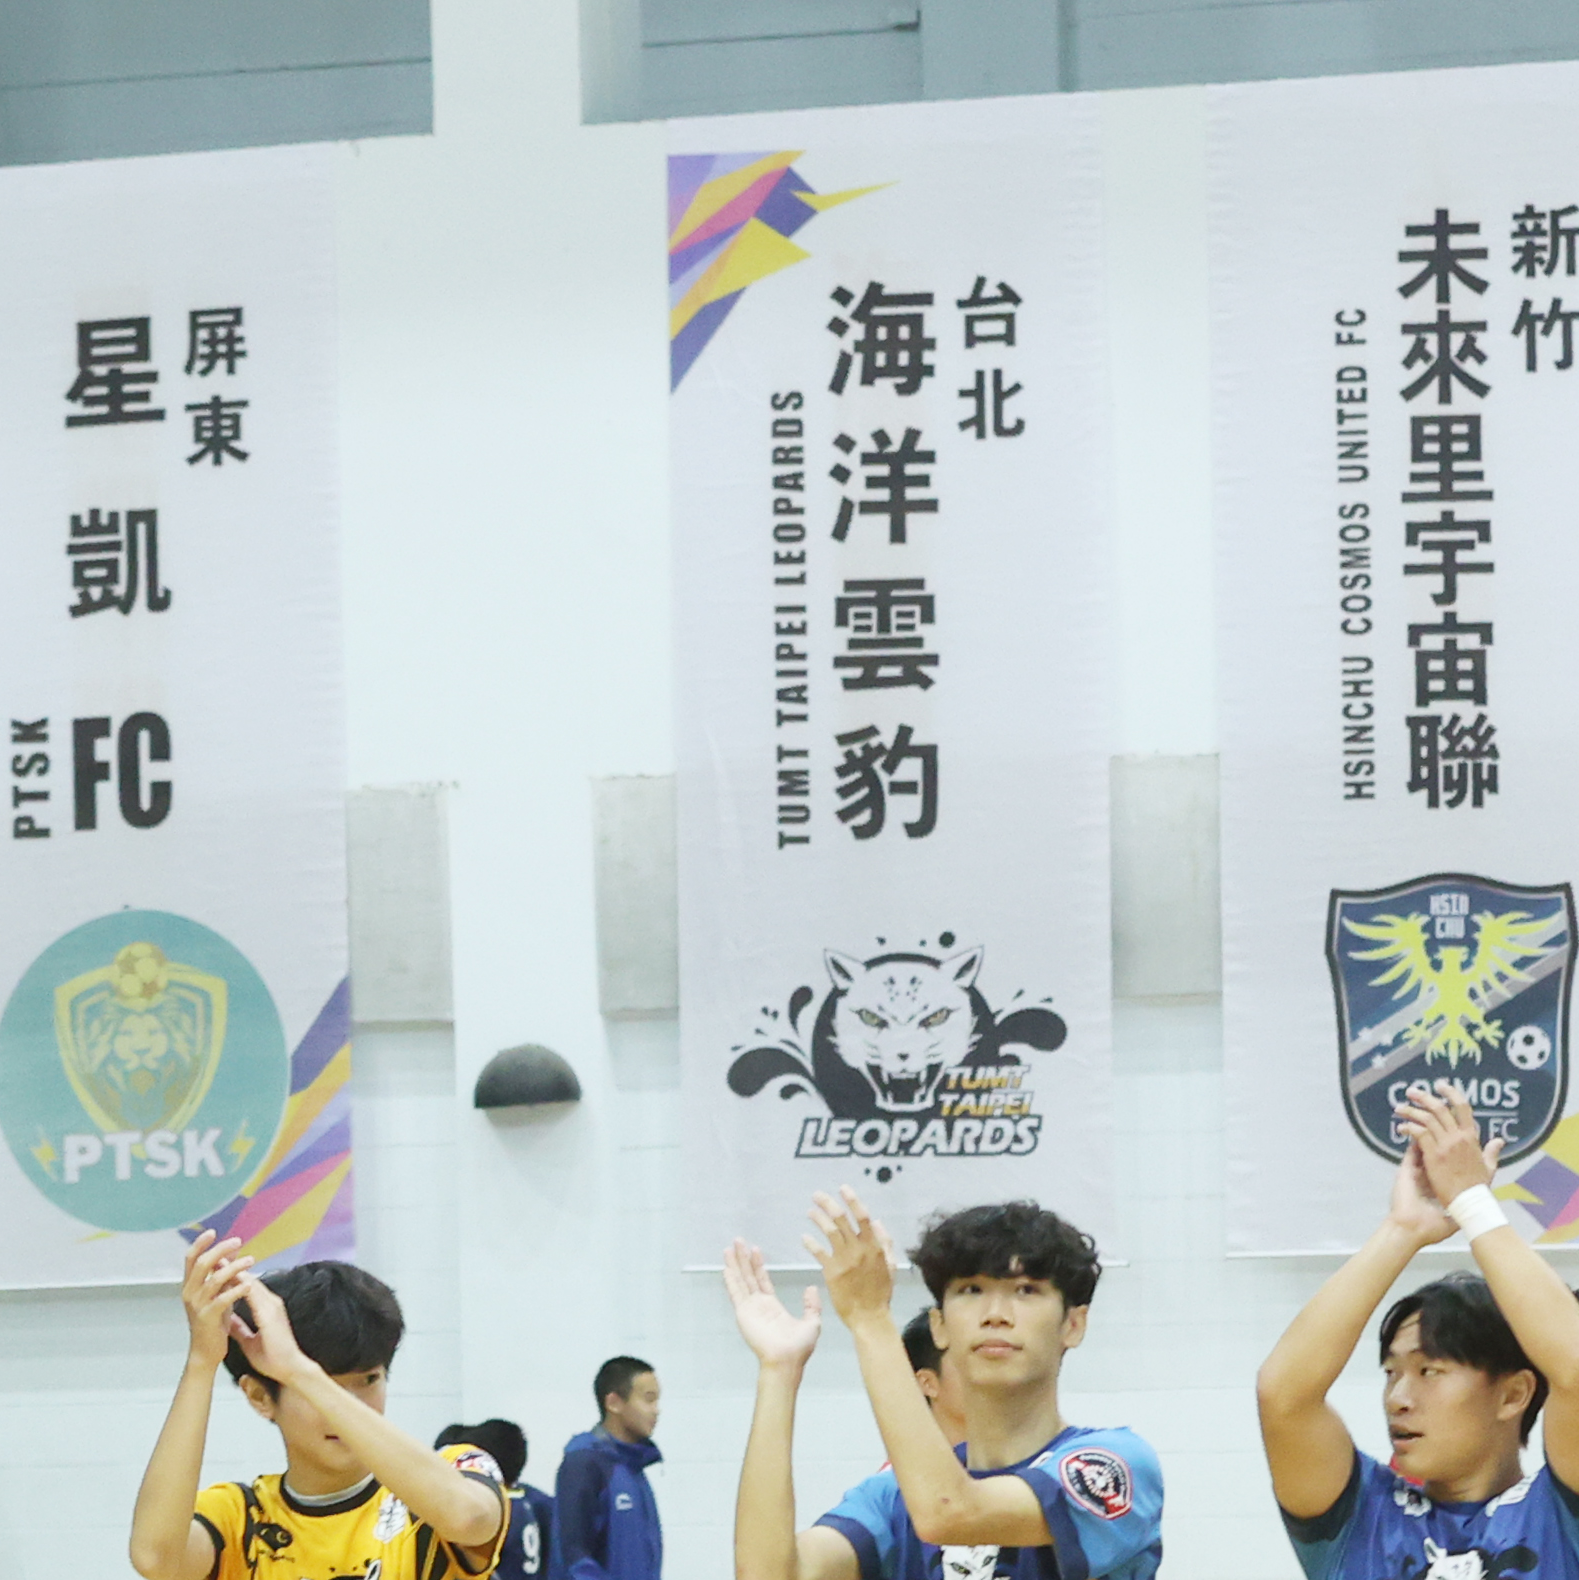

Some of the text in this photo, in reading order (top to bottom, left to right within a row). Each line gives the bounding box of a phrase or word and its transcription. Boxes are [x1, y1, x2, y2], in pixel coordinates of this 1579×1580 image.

[183, 306, 251, 467] 屏東
[956, 274, 1026, 440] 台北
[827, 281, 940, 840] 海洋雲豹
[1335, 307, 1376, 801] HSINCHU COSMOS UNITED FC
[1397, 208, 1500, 809] 未來里宇宙聯
[64, 316, 173, 830] 星凱 FC
[771, 390, 811, 850] TUMT TAIPEI LEOPARDS
[10, 716, 52, 839] PTSK
[1429, 893, 1470, 917] HSIN
[1435, 916, 1465, 939] CHU
[794, 1115, 1043, 1158] LEOPARDS
[939, 1091, 1035, 1116] TAIPEI
[945, 1064, 1031, 1090] TUMT
[1489, 1118, 1519, 1143] FC
[62, 1128, 225, 1184] PTSK
